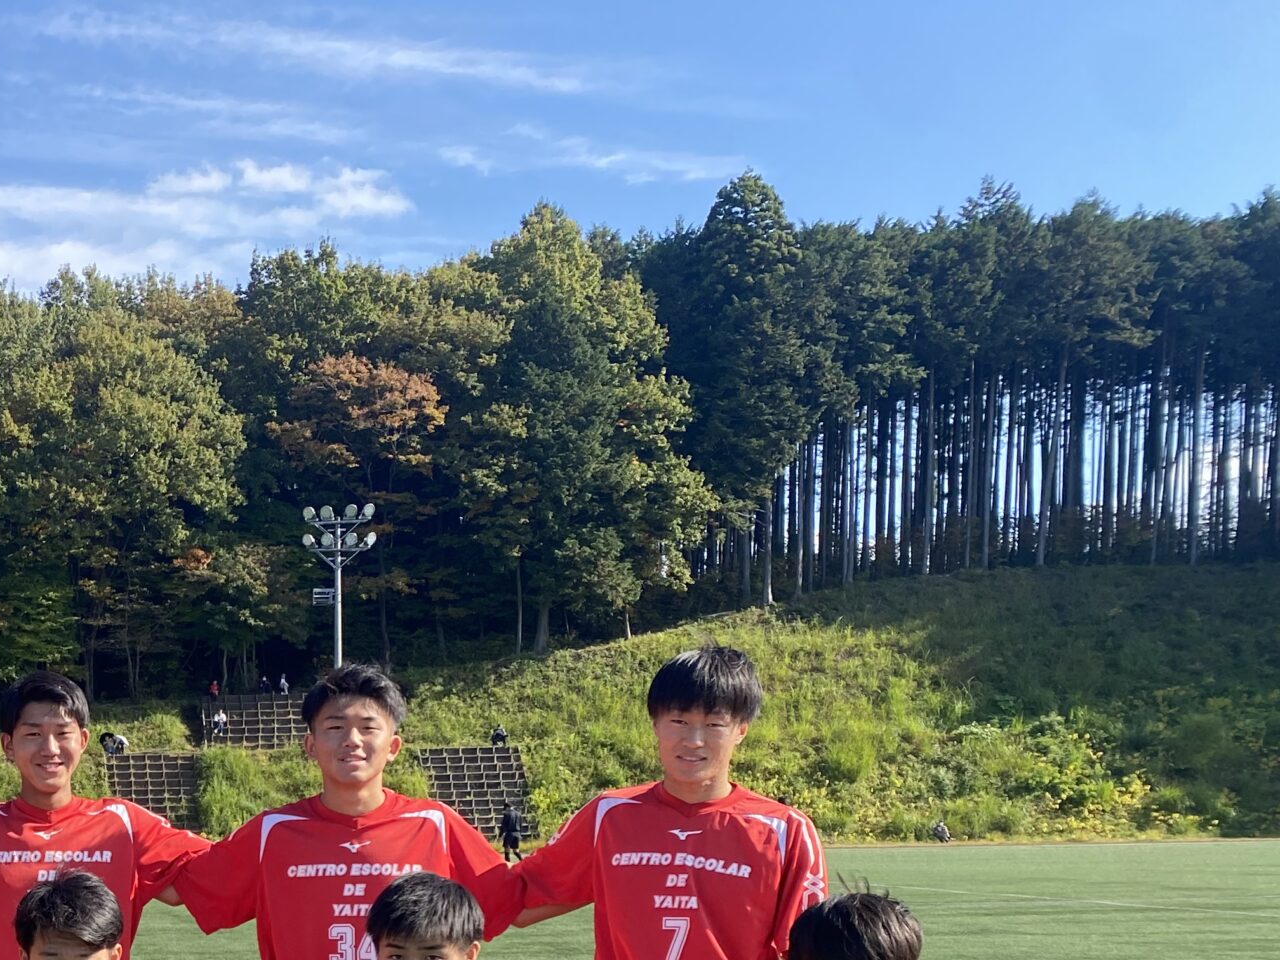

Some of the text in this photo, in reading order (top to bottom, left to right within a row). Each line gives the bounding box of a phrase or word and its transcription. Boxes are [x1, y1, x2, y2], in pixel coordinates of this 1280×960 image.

[44, 850, 112, 863] ESCOLAR
[287, 863, 347, 877] CENTRO
[612, 852, 752, 878] CENTRO ESCOLAR
[37, 869, 58, 881] DE
[665, 873, 689, 887] DE
[343, 883, 367, 897] DE
[653, 895, 698, 909] YAITA
